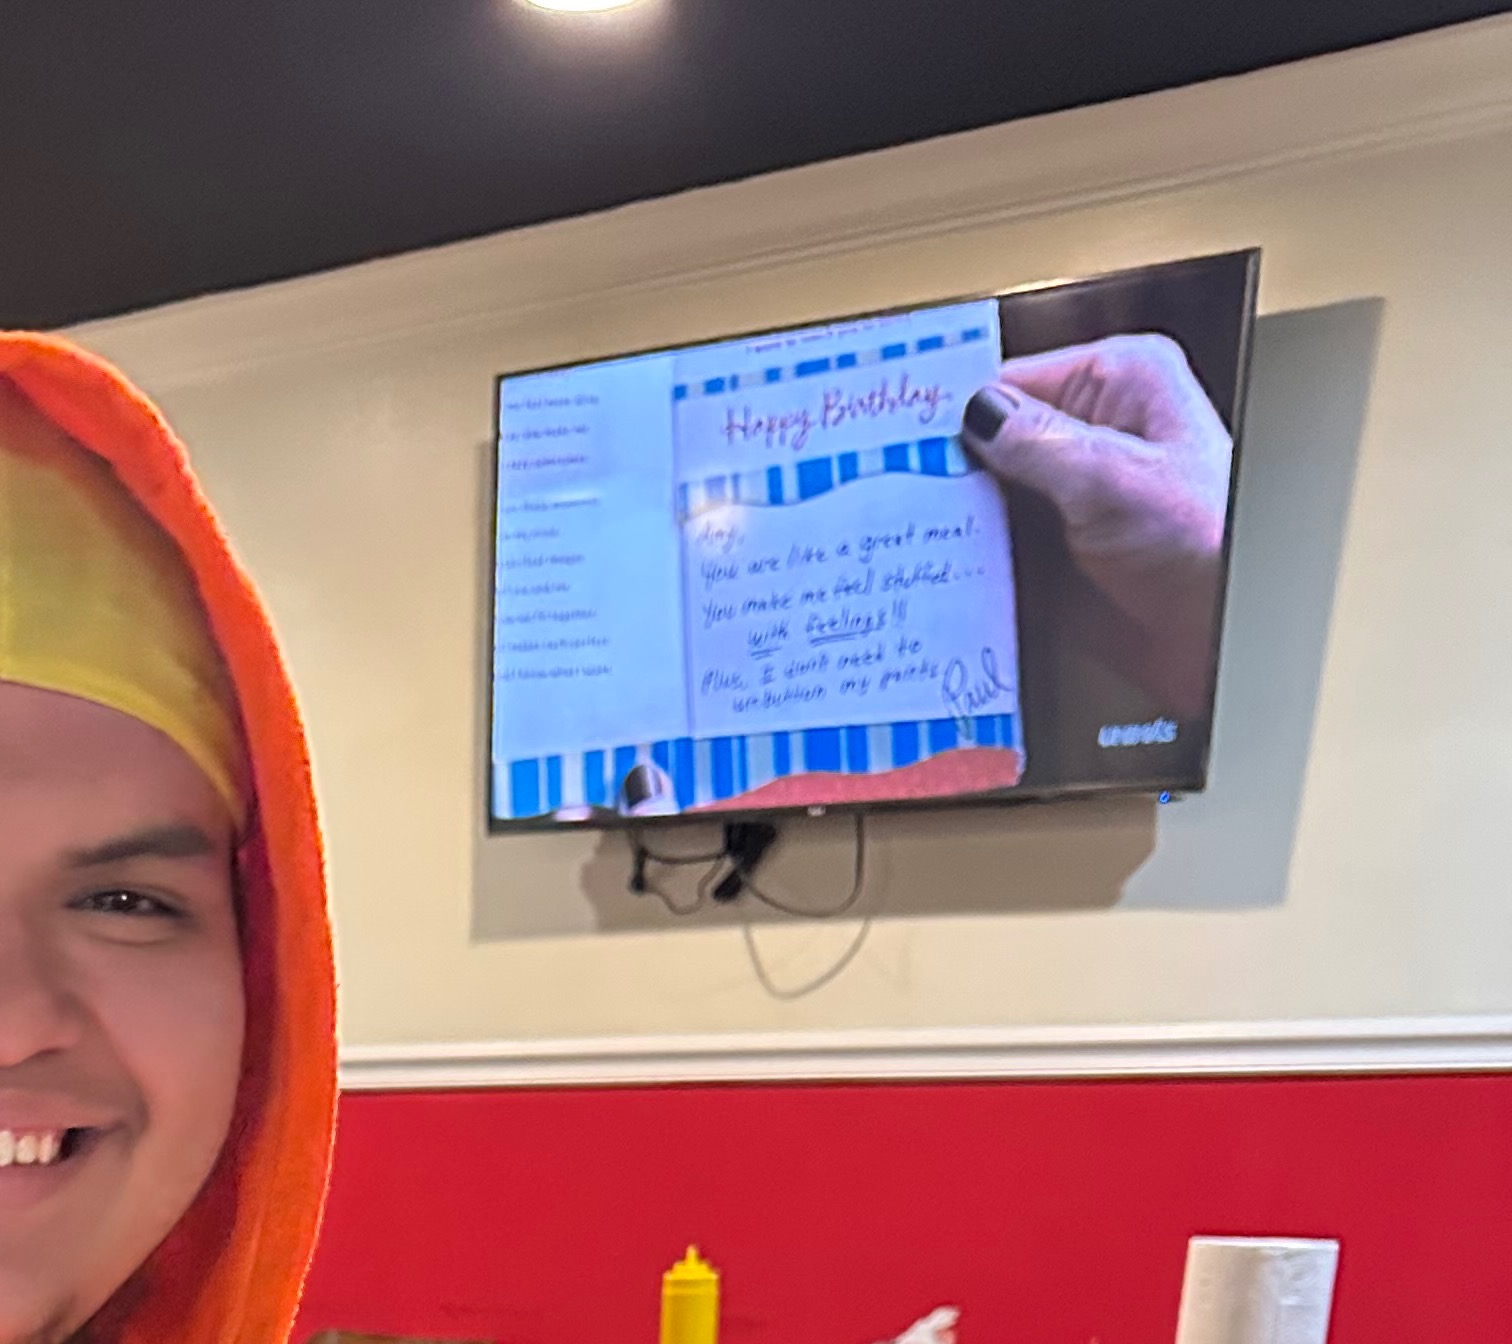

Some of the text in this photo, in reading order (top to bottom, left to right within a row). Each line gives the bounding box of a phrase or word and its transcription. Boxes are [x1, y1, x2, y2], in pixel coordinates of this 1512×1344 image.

[722, 372, 946, 450] Happy Birthday
[858, 522, 916, 565] great
